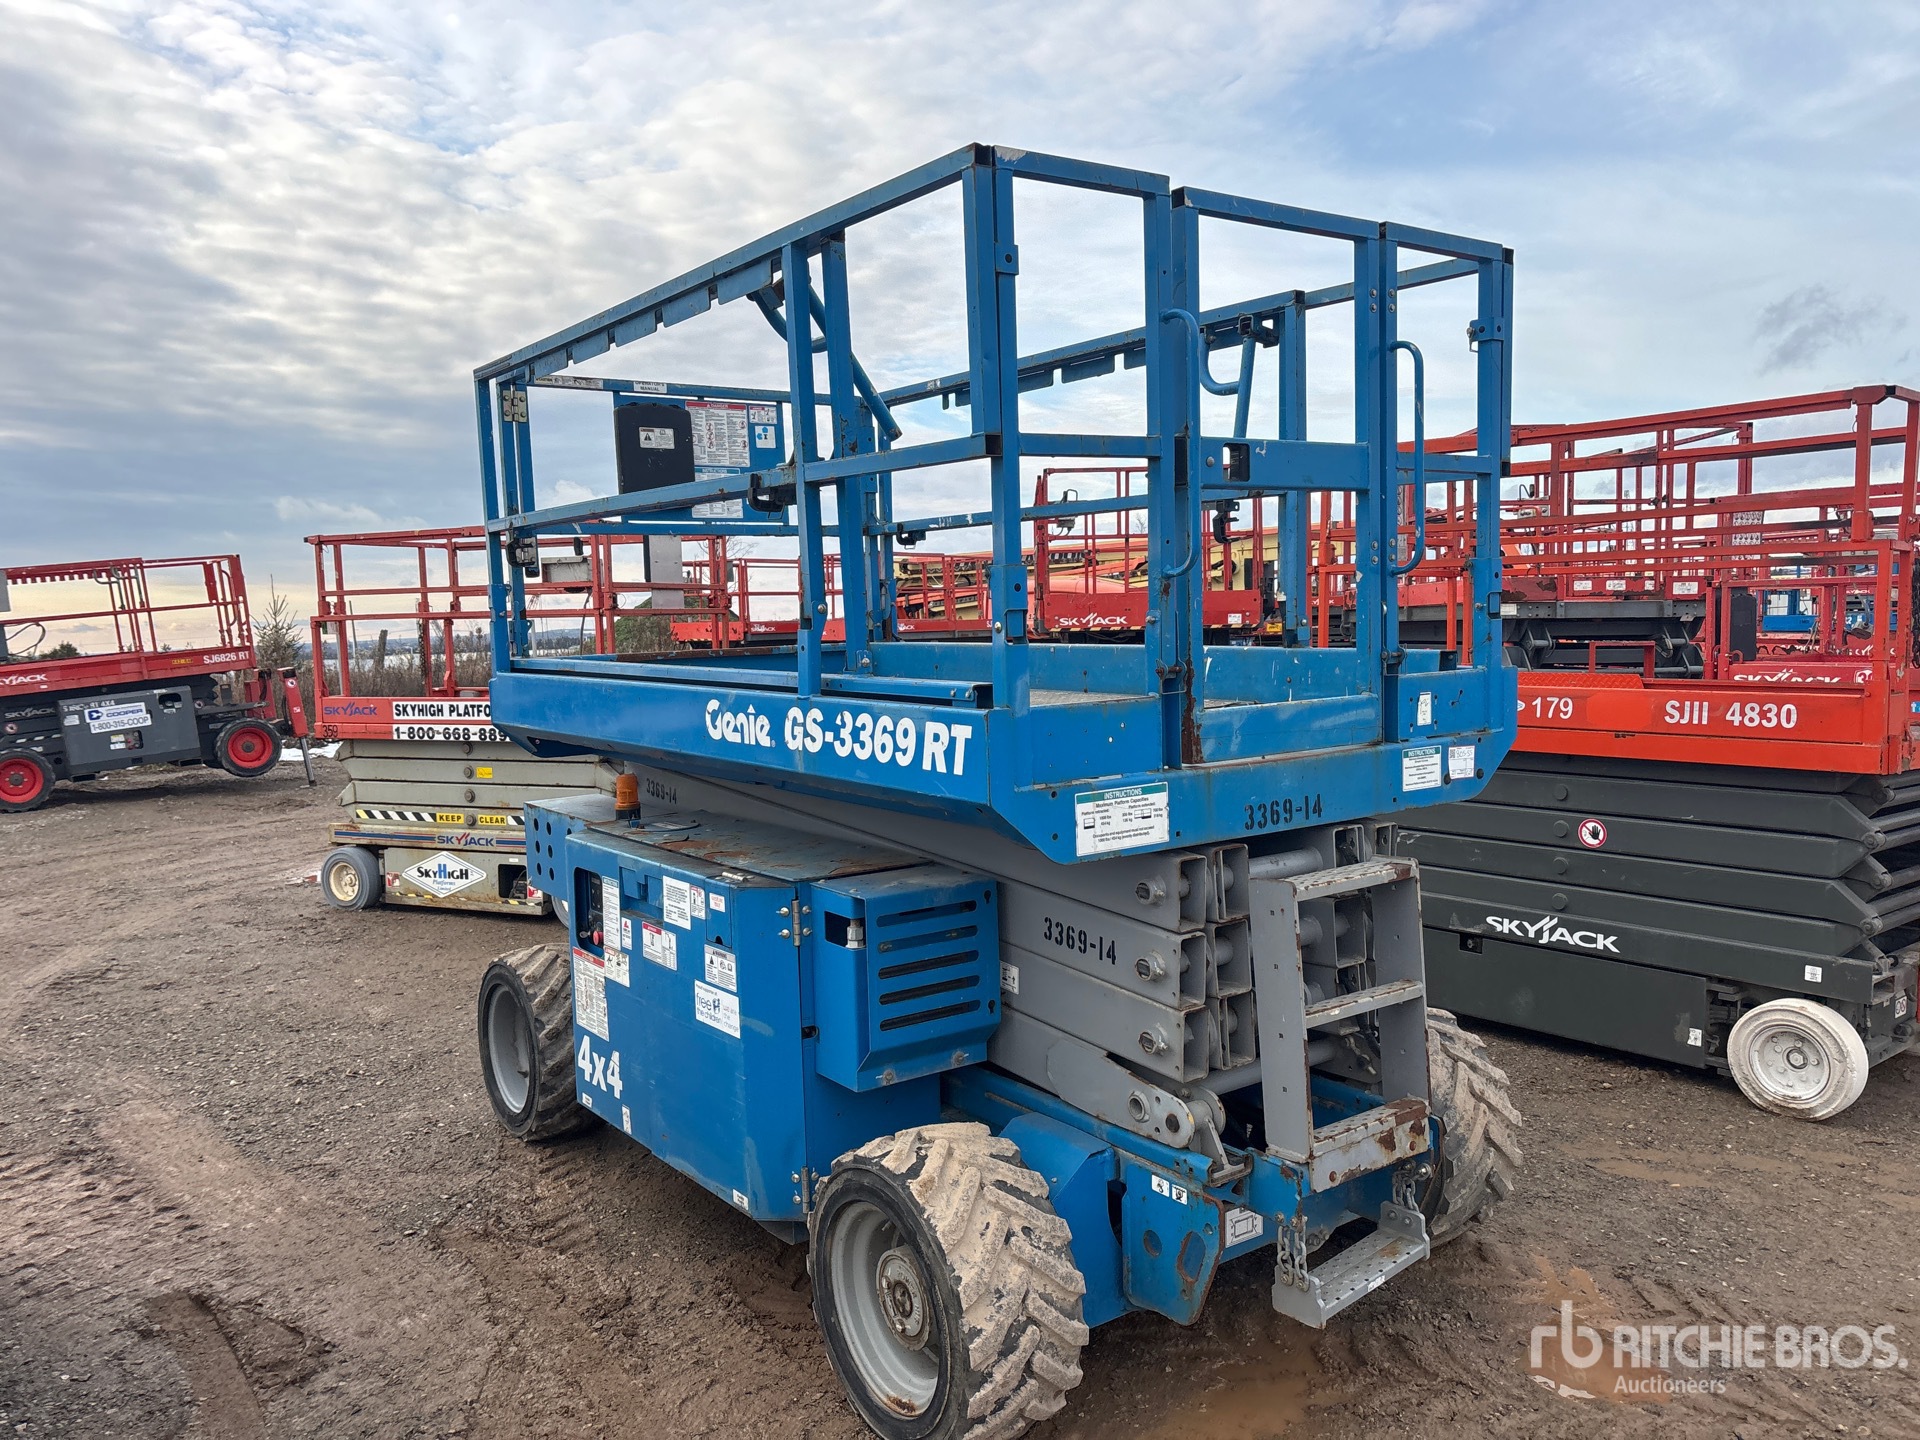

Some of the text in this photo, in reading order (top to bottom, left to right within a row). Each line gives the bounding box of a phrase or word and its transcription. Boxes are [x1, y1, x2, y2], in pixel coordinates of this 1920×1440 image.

[1059, 612, 1128, 627] SKYJACK
[203, 652, 237, 664] SJ6826
[238, 651, 250, 660] RT
[5, 707, 56, 719] SKYJACK
[106, 708, 143, 718] COOPER
[324, 702, 377, 716] SKYJACK
[394, 703, 444, 717] SKYHIGH
[1532, 697, 1573, 719] 179
[1725, 702, 1798, 728] 4830
[92, 716, 149, 731] 1-800-315-COOP
[322, 724, 338, 738] 359
[705, 699, 972, 776] Genie GS-3369 RT
[1408, 748, 1435, 757] INSTRUCTIONS
[646, 777, 677, 805] 3369-14
[1103, 788, 1142, 800] INSTRUCTIONS
[438, 814, 506, 824] KEEP CLEAR
[1244, 793, 1323, 831] 3369-14
[437, 832, 494, 847] SKYJACK
[1043, 916, 1117, 965] 3369-14
[1485, 915, 1621, 953] SKYJACK
[696, 993, 712, 1011] free
[577, 1035, 623, 1100] 4x4
